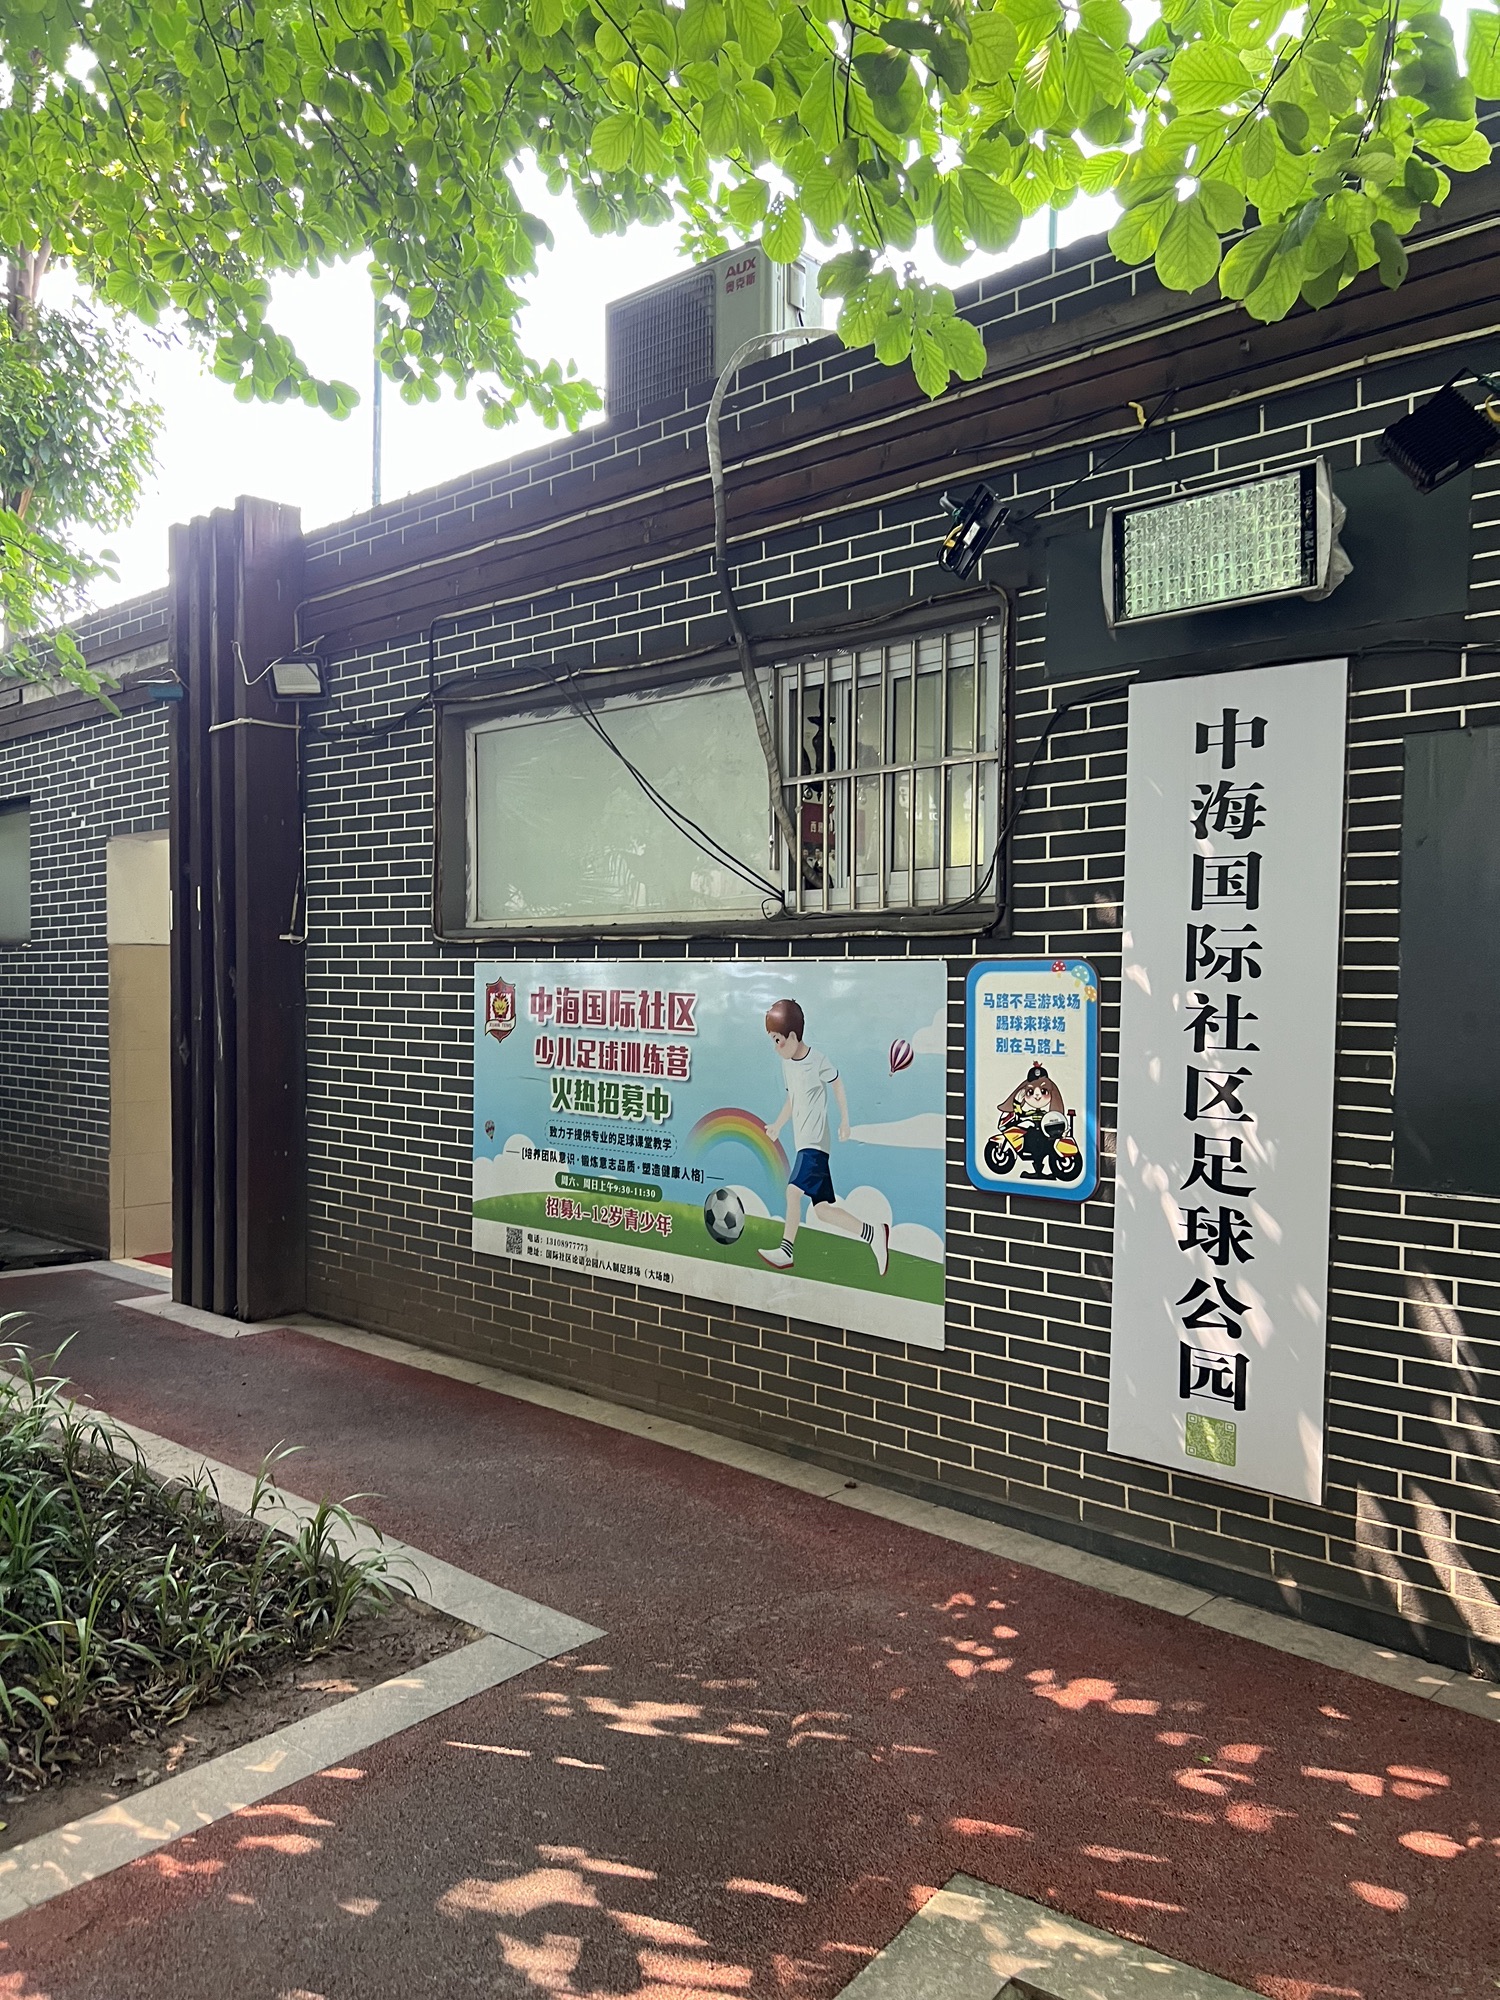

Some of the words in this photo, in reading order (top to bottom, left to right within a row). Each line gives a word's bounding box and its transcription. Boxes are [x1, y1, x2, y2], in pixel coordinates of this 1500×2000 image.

[725, 256, 756, 280] AUX
[725, 271, 756, 294] 奥克斯
[529, 985, 697, 1033] 中海国际社区
[983, 993, 1081, 1010] 马路不是游戏场
[996, 1015, 1066, 1033] 踢球来球场
[534, 1035, 690, 1078] 少儿足球训练营
[996, 1037, 1066, 1055] 别在马路上
[1175, 707, 1269, 1412] 中海国际社区足球公园
[551, 1076, 670, 1121] 火热招募中
[549, 1125, 672, 1151] 致力于提供专业的足球课堂教学
[545, 1195, 672, 1236] 招募4-12岁青少年
